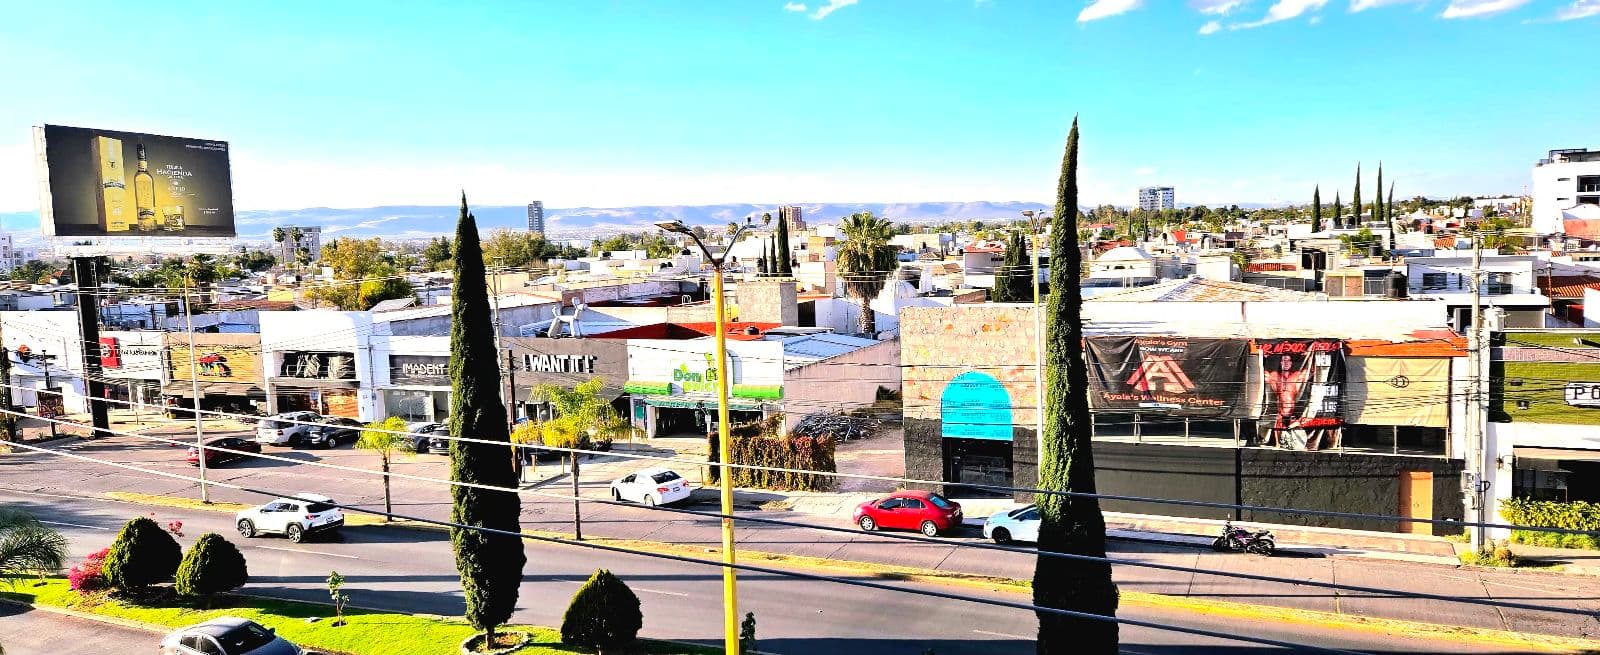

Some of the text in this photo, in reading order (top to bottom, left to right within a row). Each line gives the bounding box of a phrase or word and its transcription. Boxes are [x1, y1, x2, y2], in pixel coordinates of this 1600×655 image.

[156, 168, 193, 177] HACIENDA
[1134, 338, 1188, 348] Ayala's Gym
[402, 363, 445, 375] IMADENT
[529, 354, 568, 373] WANT
[674, 368, 701, 382] Don
[1103, 392, 1139, 401] Ayala's
[1187, 397, 1225, 406] Center
